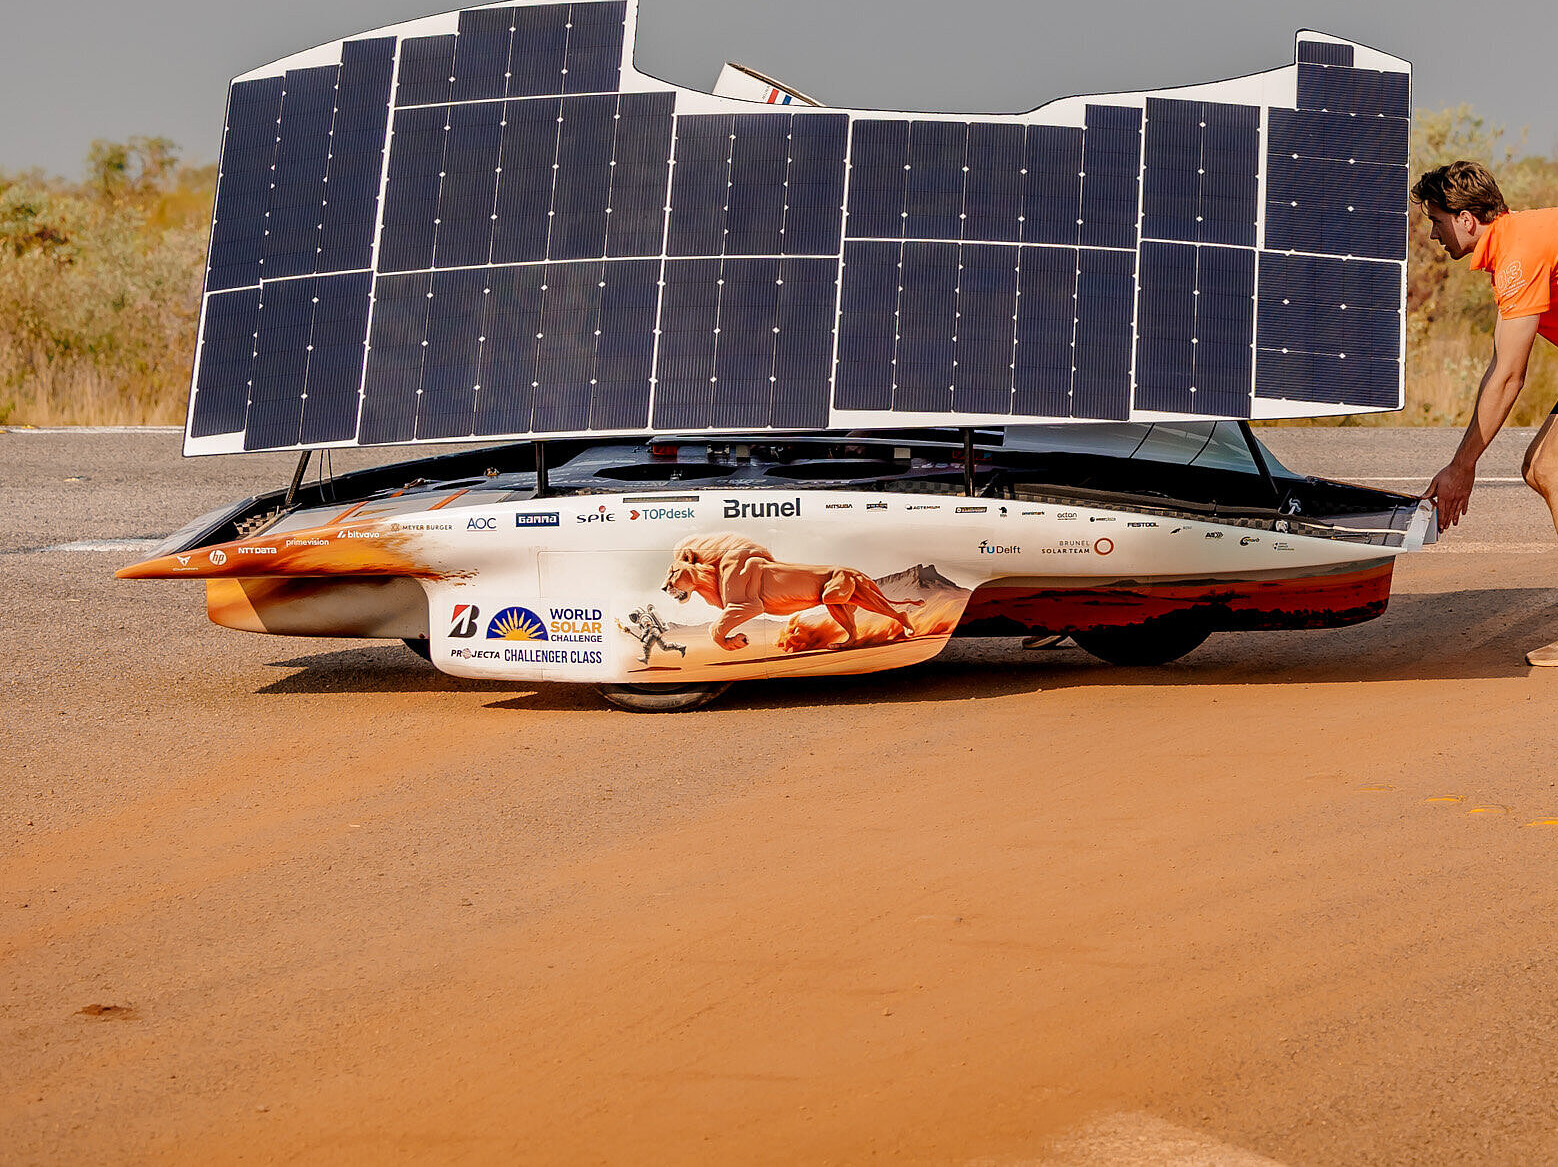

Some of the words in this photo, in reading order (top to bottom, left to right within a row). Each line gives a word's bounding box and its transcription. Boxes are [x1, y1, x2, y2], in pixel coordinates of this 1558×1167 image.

[642, 507, 695, 520] TOPdesk
[723, 497, 801, 519] Brunel
[466, 517, 497, 530] AOC
[347, 530, 380, 539] bitvavo
[285, 537, 330, 547] primevision
[978, 544, 995, 554] TU
[996, 545, 1021, 554] Delft
[211, 551, 225, 565] hp
[549, 608, 603, 621] WORLD
[550, 621, 603, 633] SOLAR
[550, 634, 603, 642] CHALLENGE
[504, 649, 568, 664] CHALLENGER
[570, 650, 602, 664] CLASS
